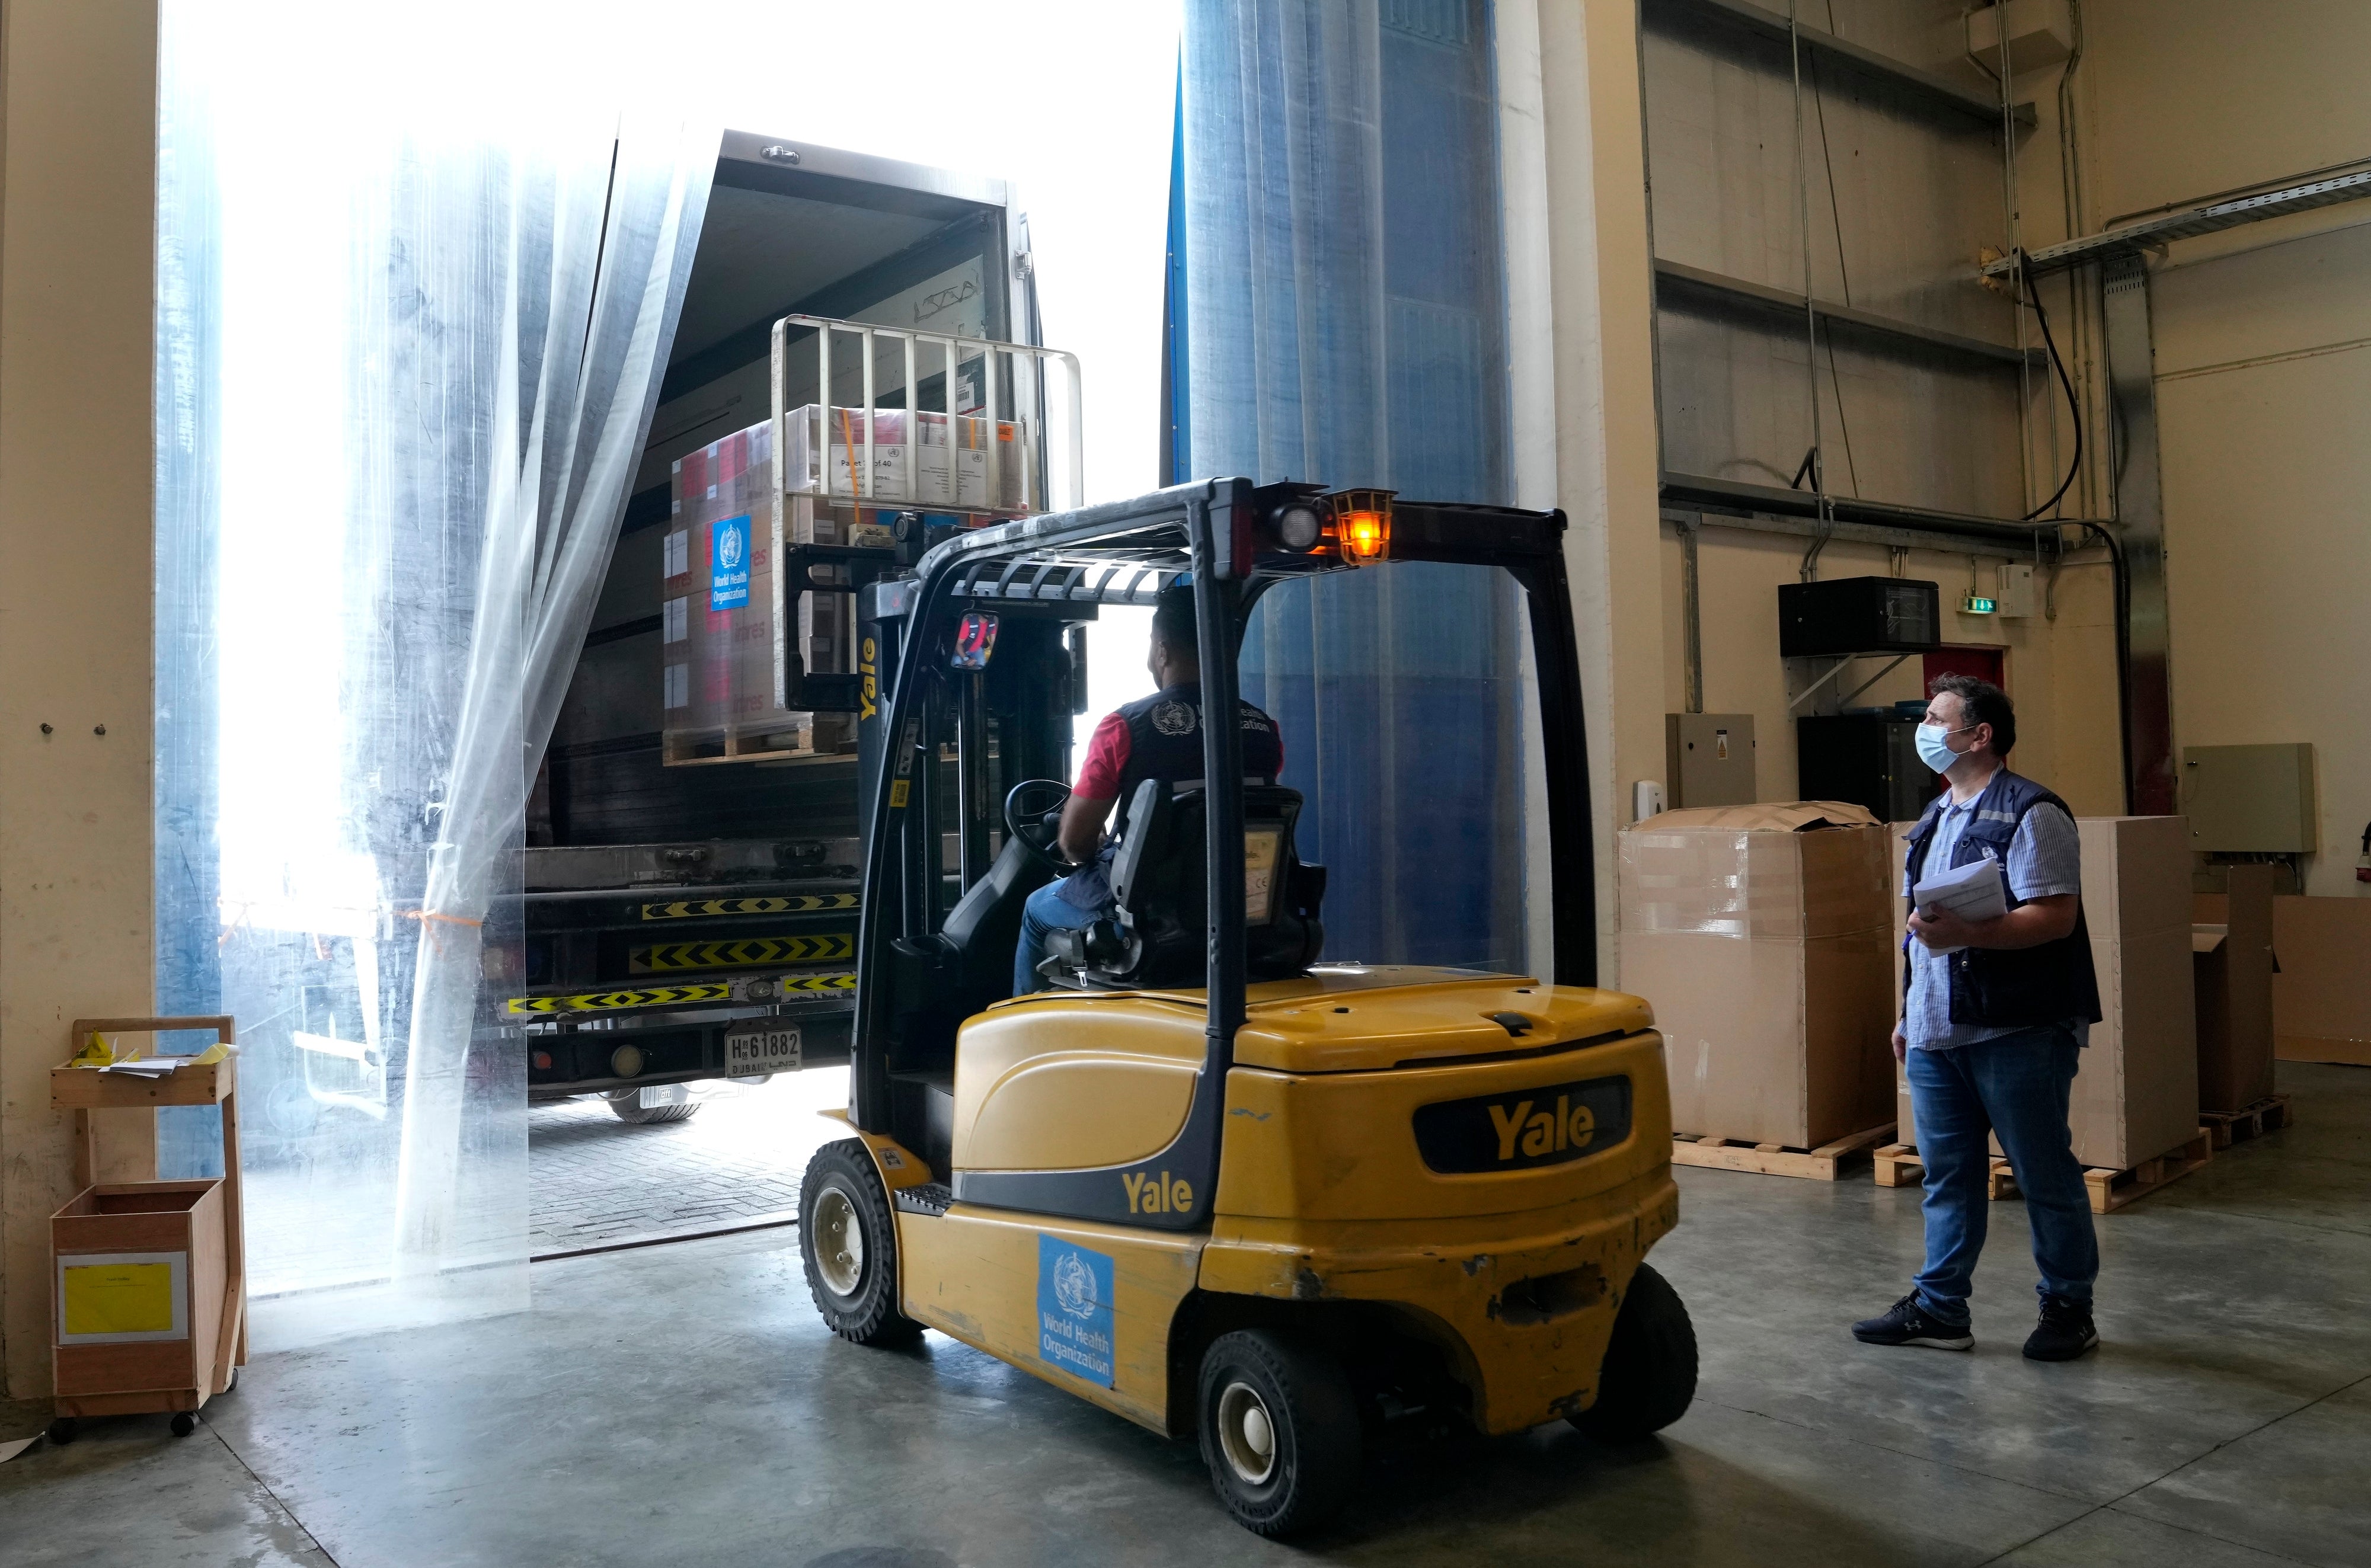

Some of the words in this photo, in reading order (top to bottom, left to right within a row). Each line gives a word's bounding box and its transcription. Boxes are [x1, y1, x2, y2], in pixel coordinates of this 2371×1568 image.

[714, 573, 729, 588] World
[730, 570, 747, 585] Health
[714, 586, 747, 605] Organization
[860, 637, 876, 721] Yale
[732, 1039, 741, 1058] H
[750, 1033, 798, 1058] 61882
[1487, 1094, 1596, 1161] Yale
[1121, 1170, 1193, 1214] Yale
[1043, 1311, 1072, 1339] World
[1075, 1324, 1109, 1354] Health
[1043, 1333, 1109, 1376] Organization
